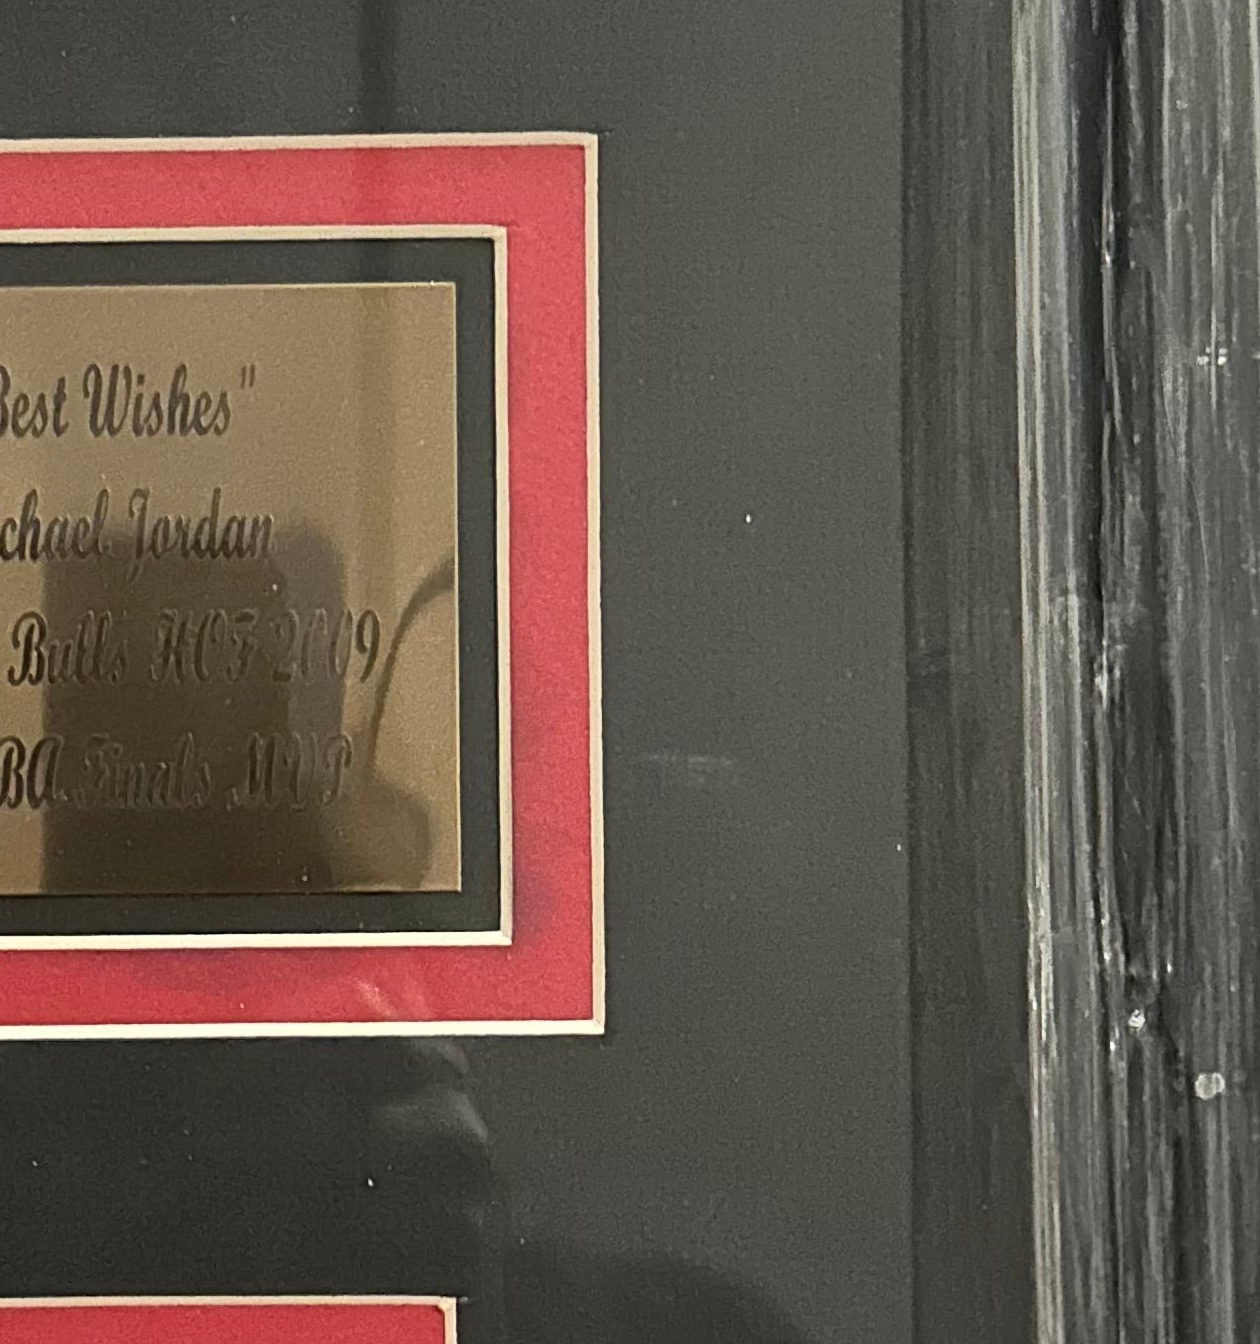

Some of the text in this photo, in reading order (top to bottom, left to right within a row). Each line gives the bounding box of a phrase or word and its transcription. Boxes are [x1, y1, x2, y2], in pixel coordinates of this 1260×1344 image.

[83, 362, 256, 437] Wishes"
[128, 487, 275, 581] Jordan
[7, 610, 128, 687] Bulls
[270, 608, 380, 684] 2009
[73, 730, 212, 810] Finals
